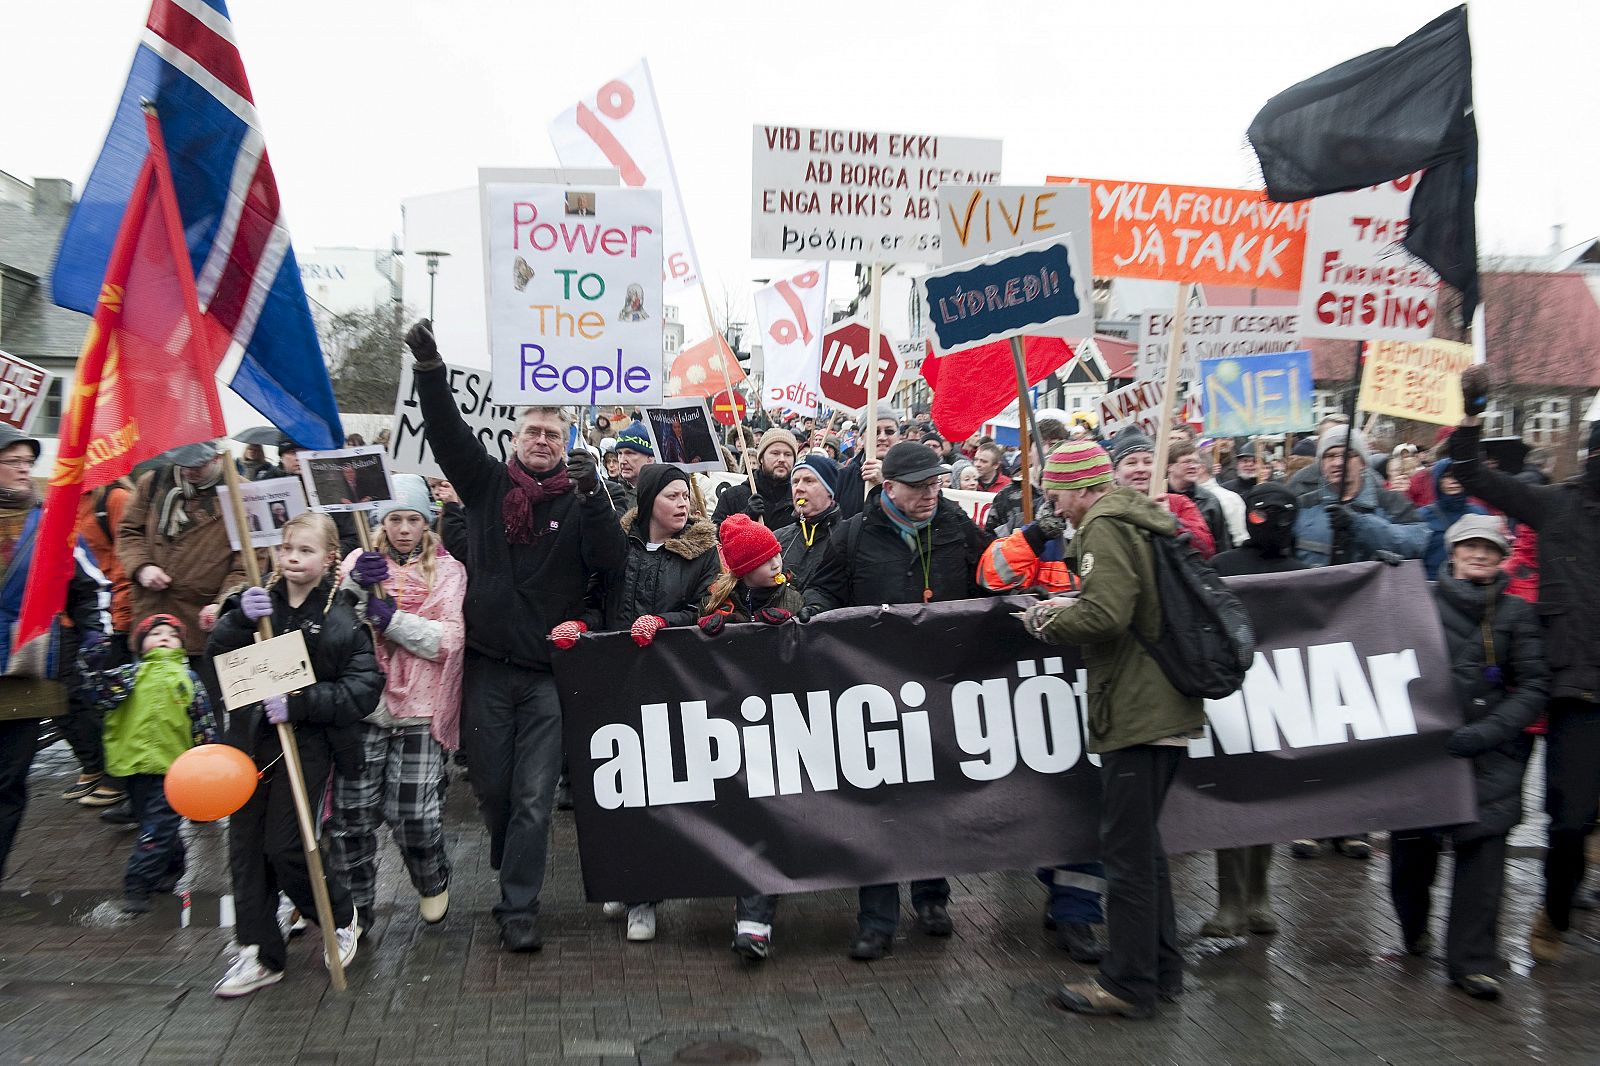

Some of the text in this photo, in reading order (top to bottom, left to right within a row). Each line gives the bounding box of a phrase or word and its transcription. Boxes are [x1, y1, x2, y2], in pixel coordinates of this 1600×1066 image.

[764, 126, 939, 160] VIÐ EIGUM EKKI
[804, 160, 833, 184] AÐ
[840, 163, 909, 190] BORGA
[762, 189, 822, 215] ENGA
[948, 188, 1057, 248] VIVE
[513, 202, 653, 258] Power
[1112, 222, 1293, 279] JÁ TAKK
[529, 304, 606, 340] The
[1147, 315, 1227, 337] EKERT
[1231, 314, 1300, 335] ICESAVE
[821, 339, 890, 391] IMF
[1145, 342, 1188, 364] ENA
[520, 344, 651, 404] People
